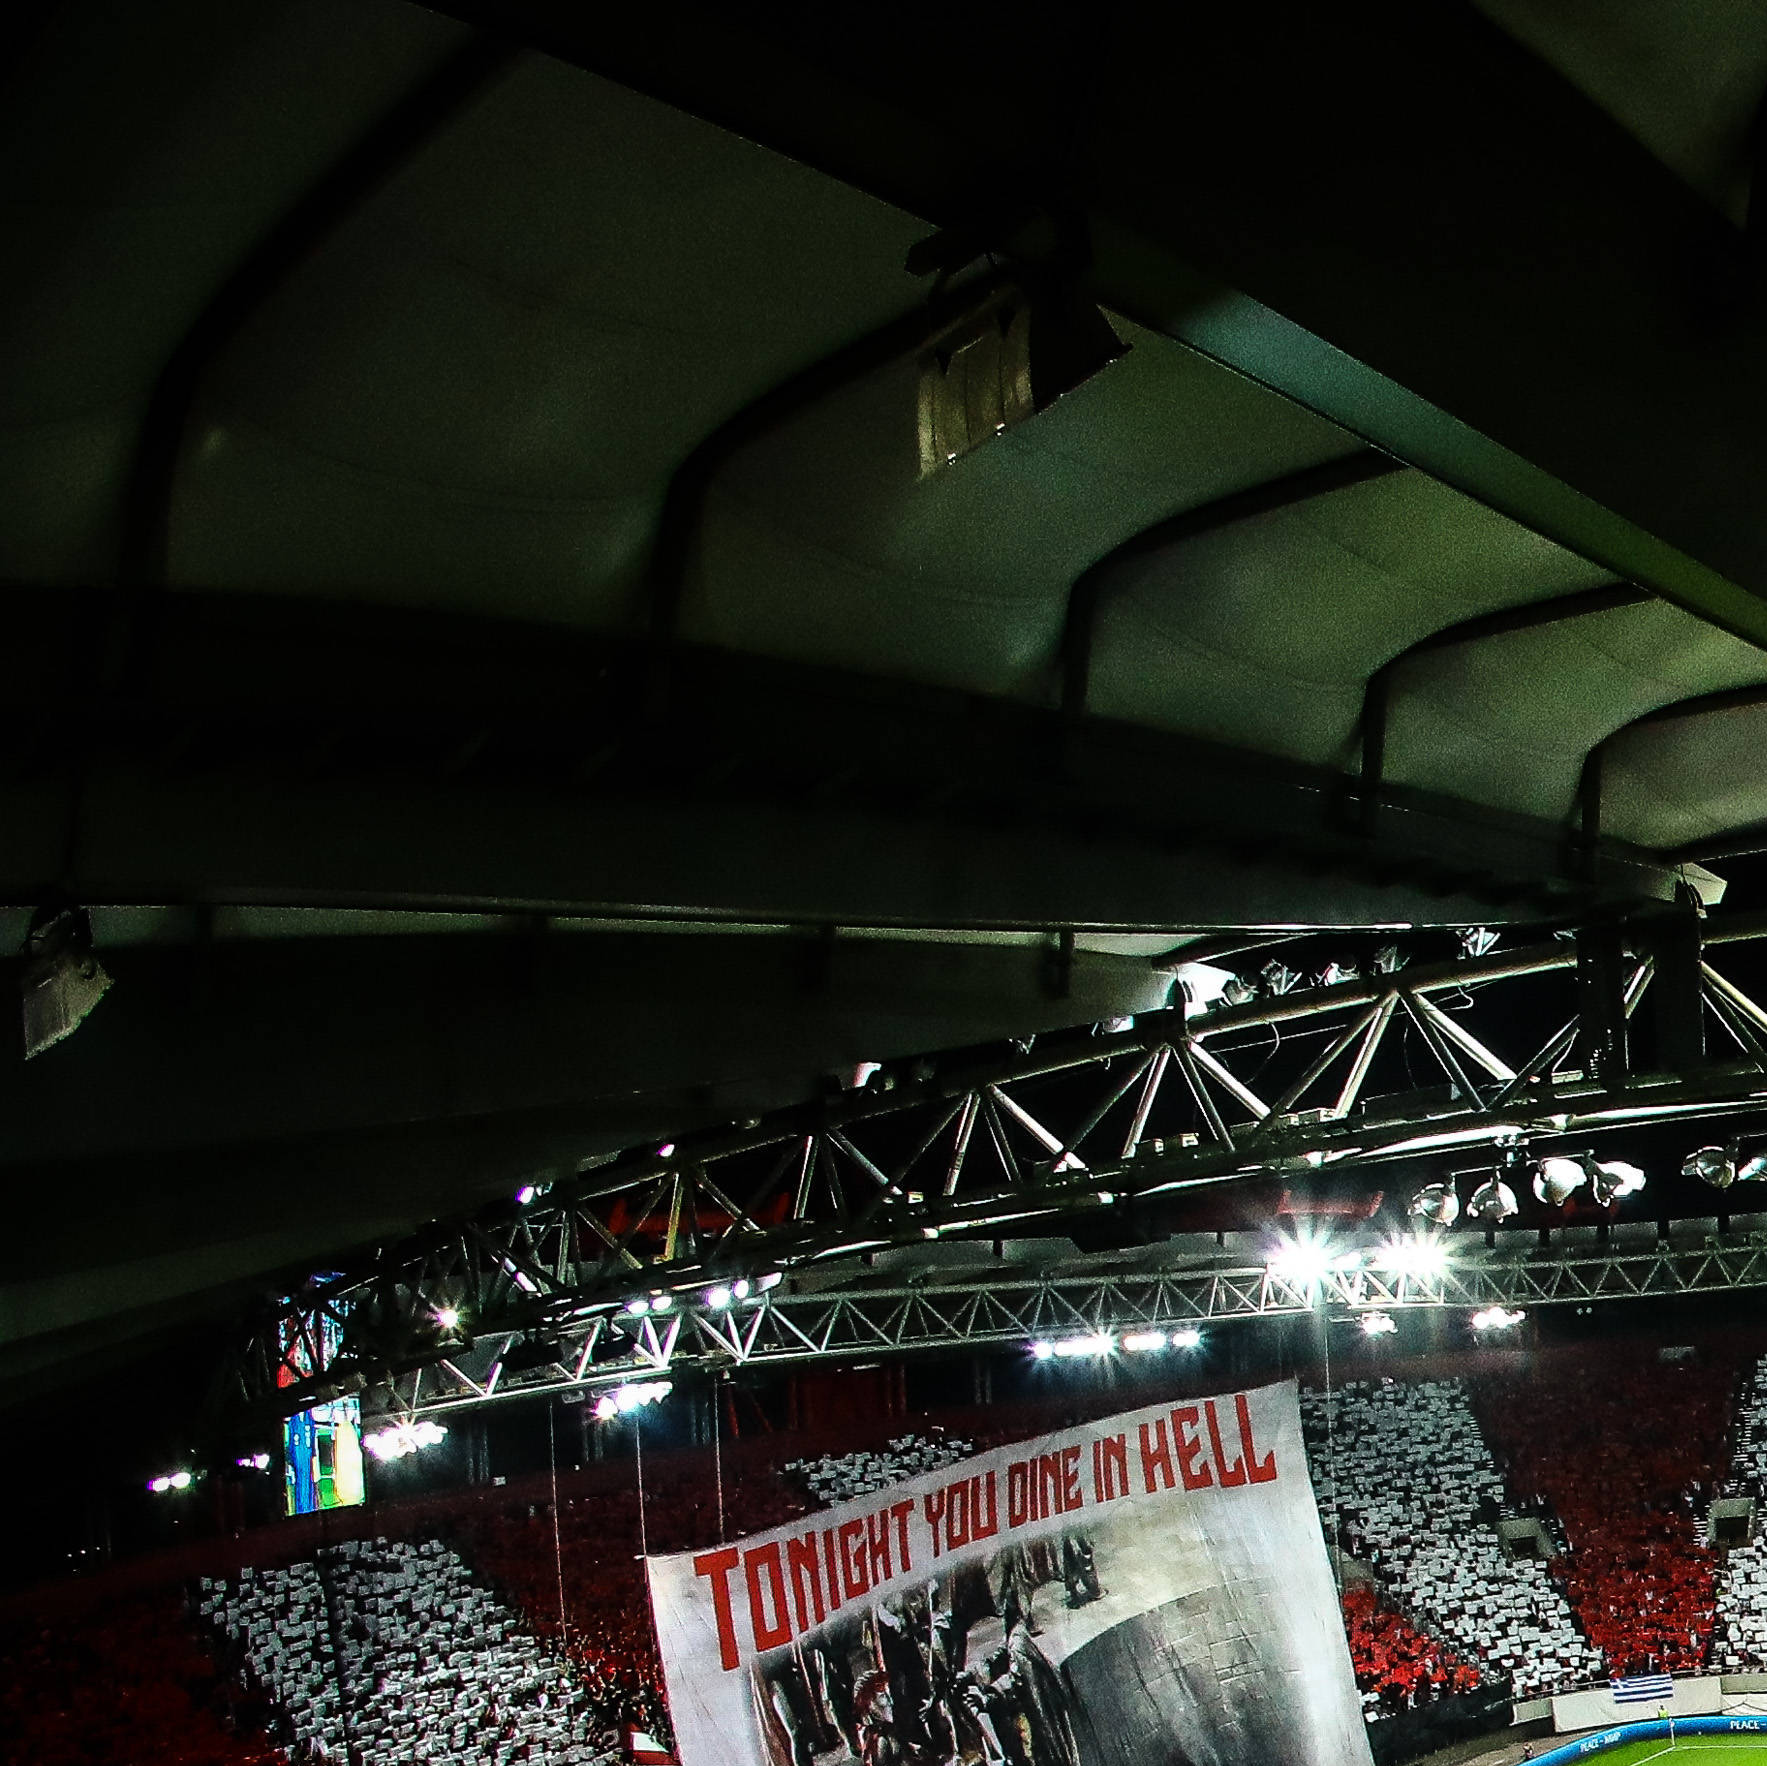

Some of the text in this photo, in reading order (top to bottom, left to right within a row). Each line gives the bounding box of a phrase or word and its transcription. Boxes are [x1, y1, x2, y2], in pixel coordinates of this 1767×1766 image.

[691, 1394, 1278, 1673] TONIGHT YOU DINE IN HELL
[1730, 1720, 1760, 1731] PEACE
